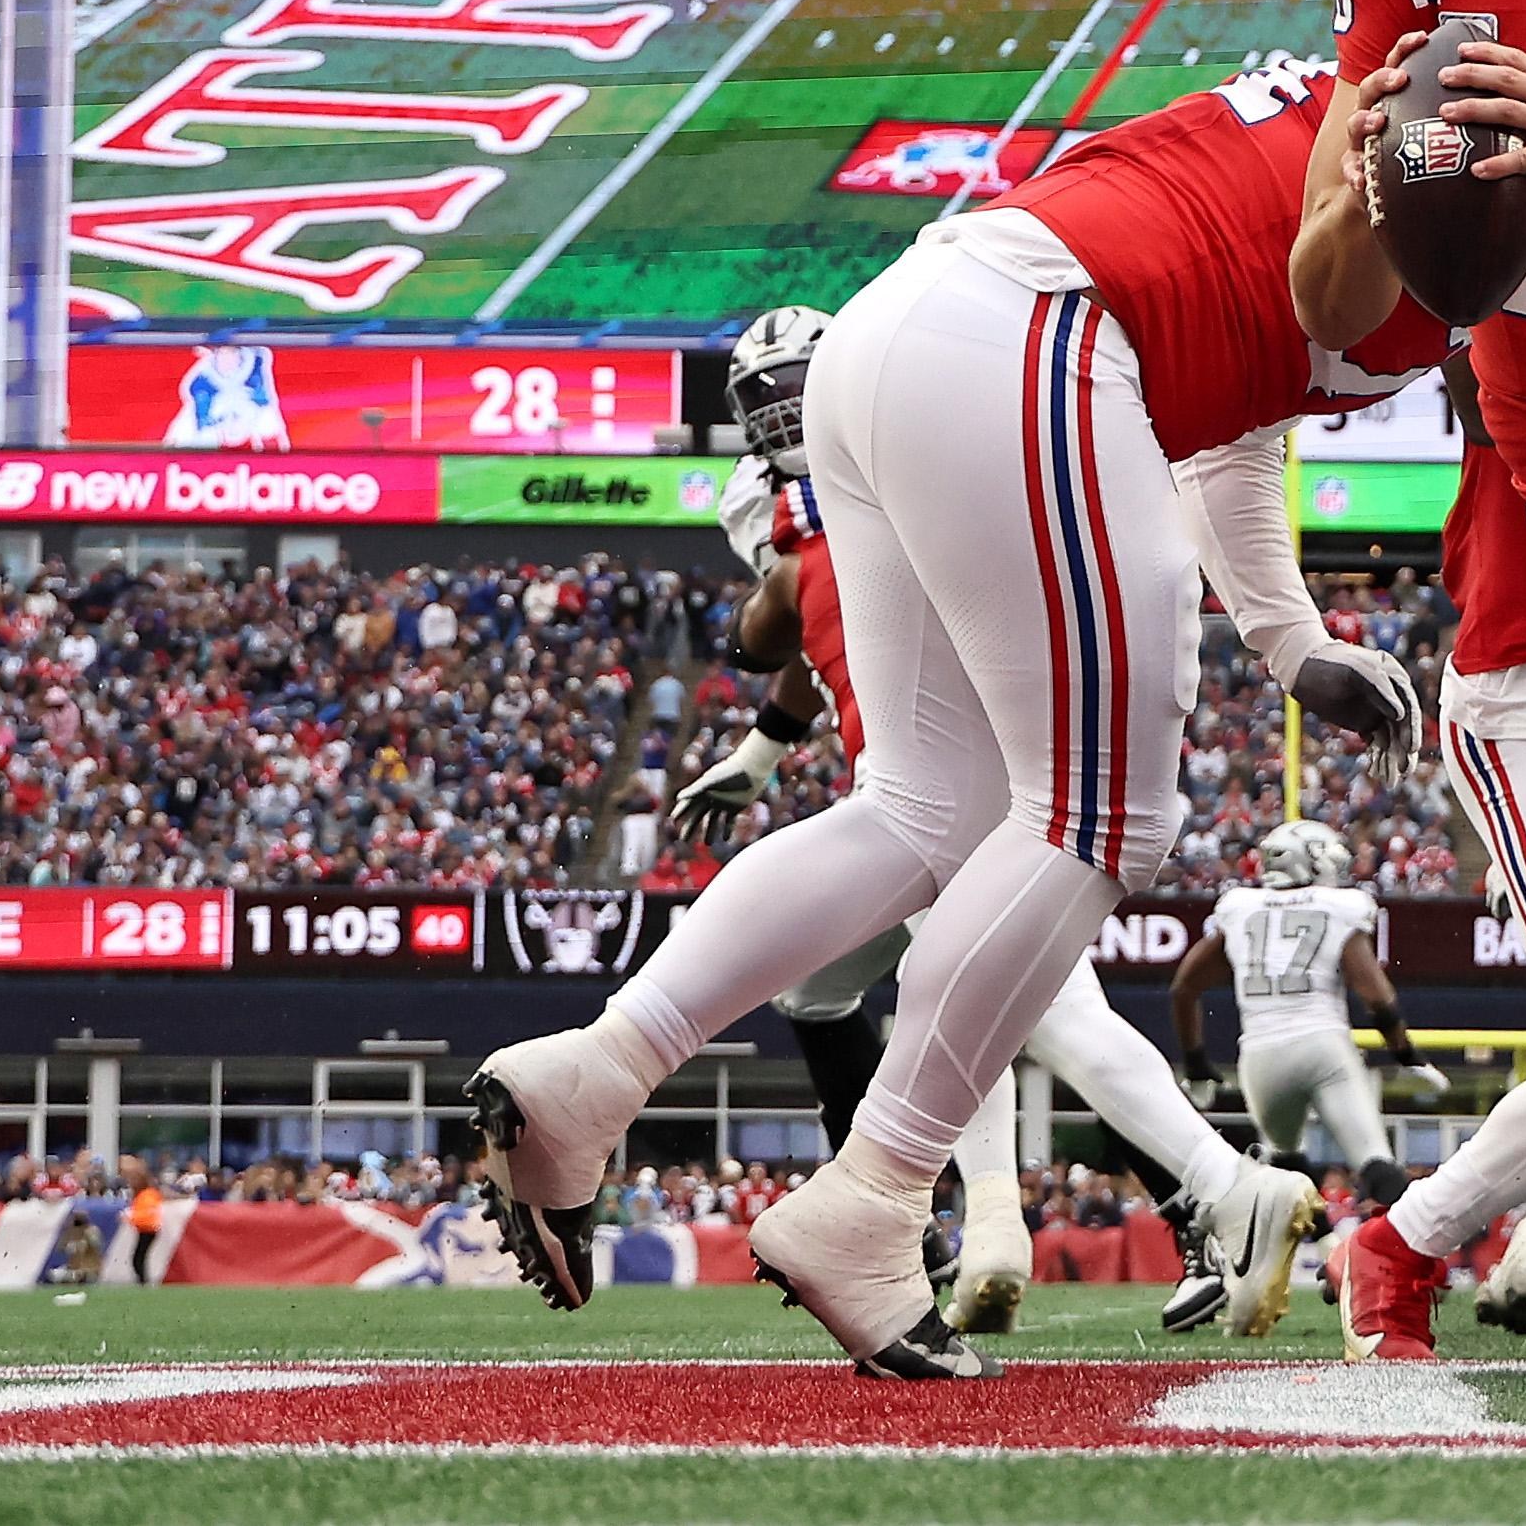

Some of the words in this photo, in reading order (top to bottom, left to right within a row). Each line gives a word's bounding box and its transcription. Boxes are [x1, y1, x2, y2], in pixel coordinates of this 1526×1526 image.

[1428, 120, 1461, 172] NFL
[470, 366, 558, 437] 28
[51, 473, 157, 512] new
[165, 465, 381, 514] balance
[523, 476, 650, 505] Gillette
[102, 901, 186, 956] 28
[246, 905, 402, 957] 11:05
[415, 914, 464, 946] 40
[1244, 910, 1328, 997] 17
